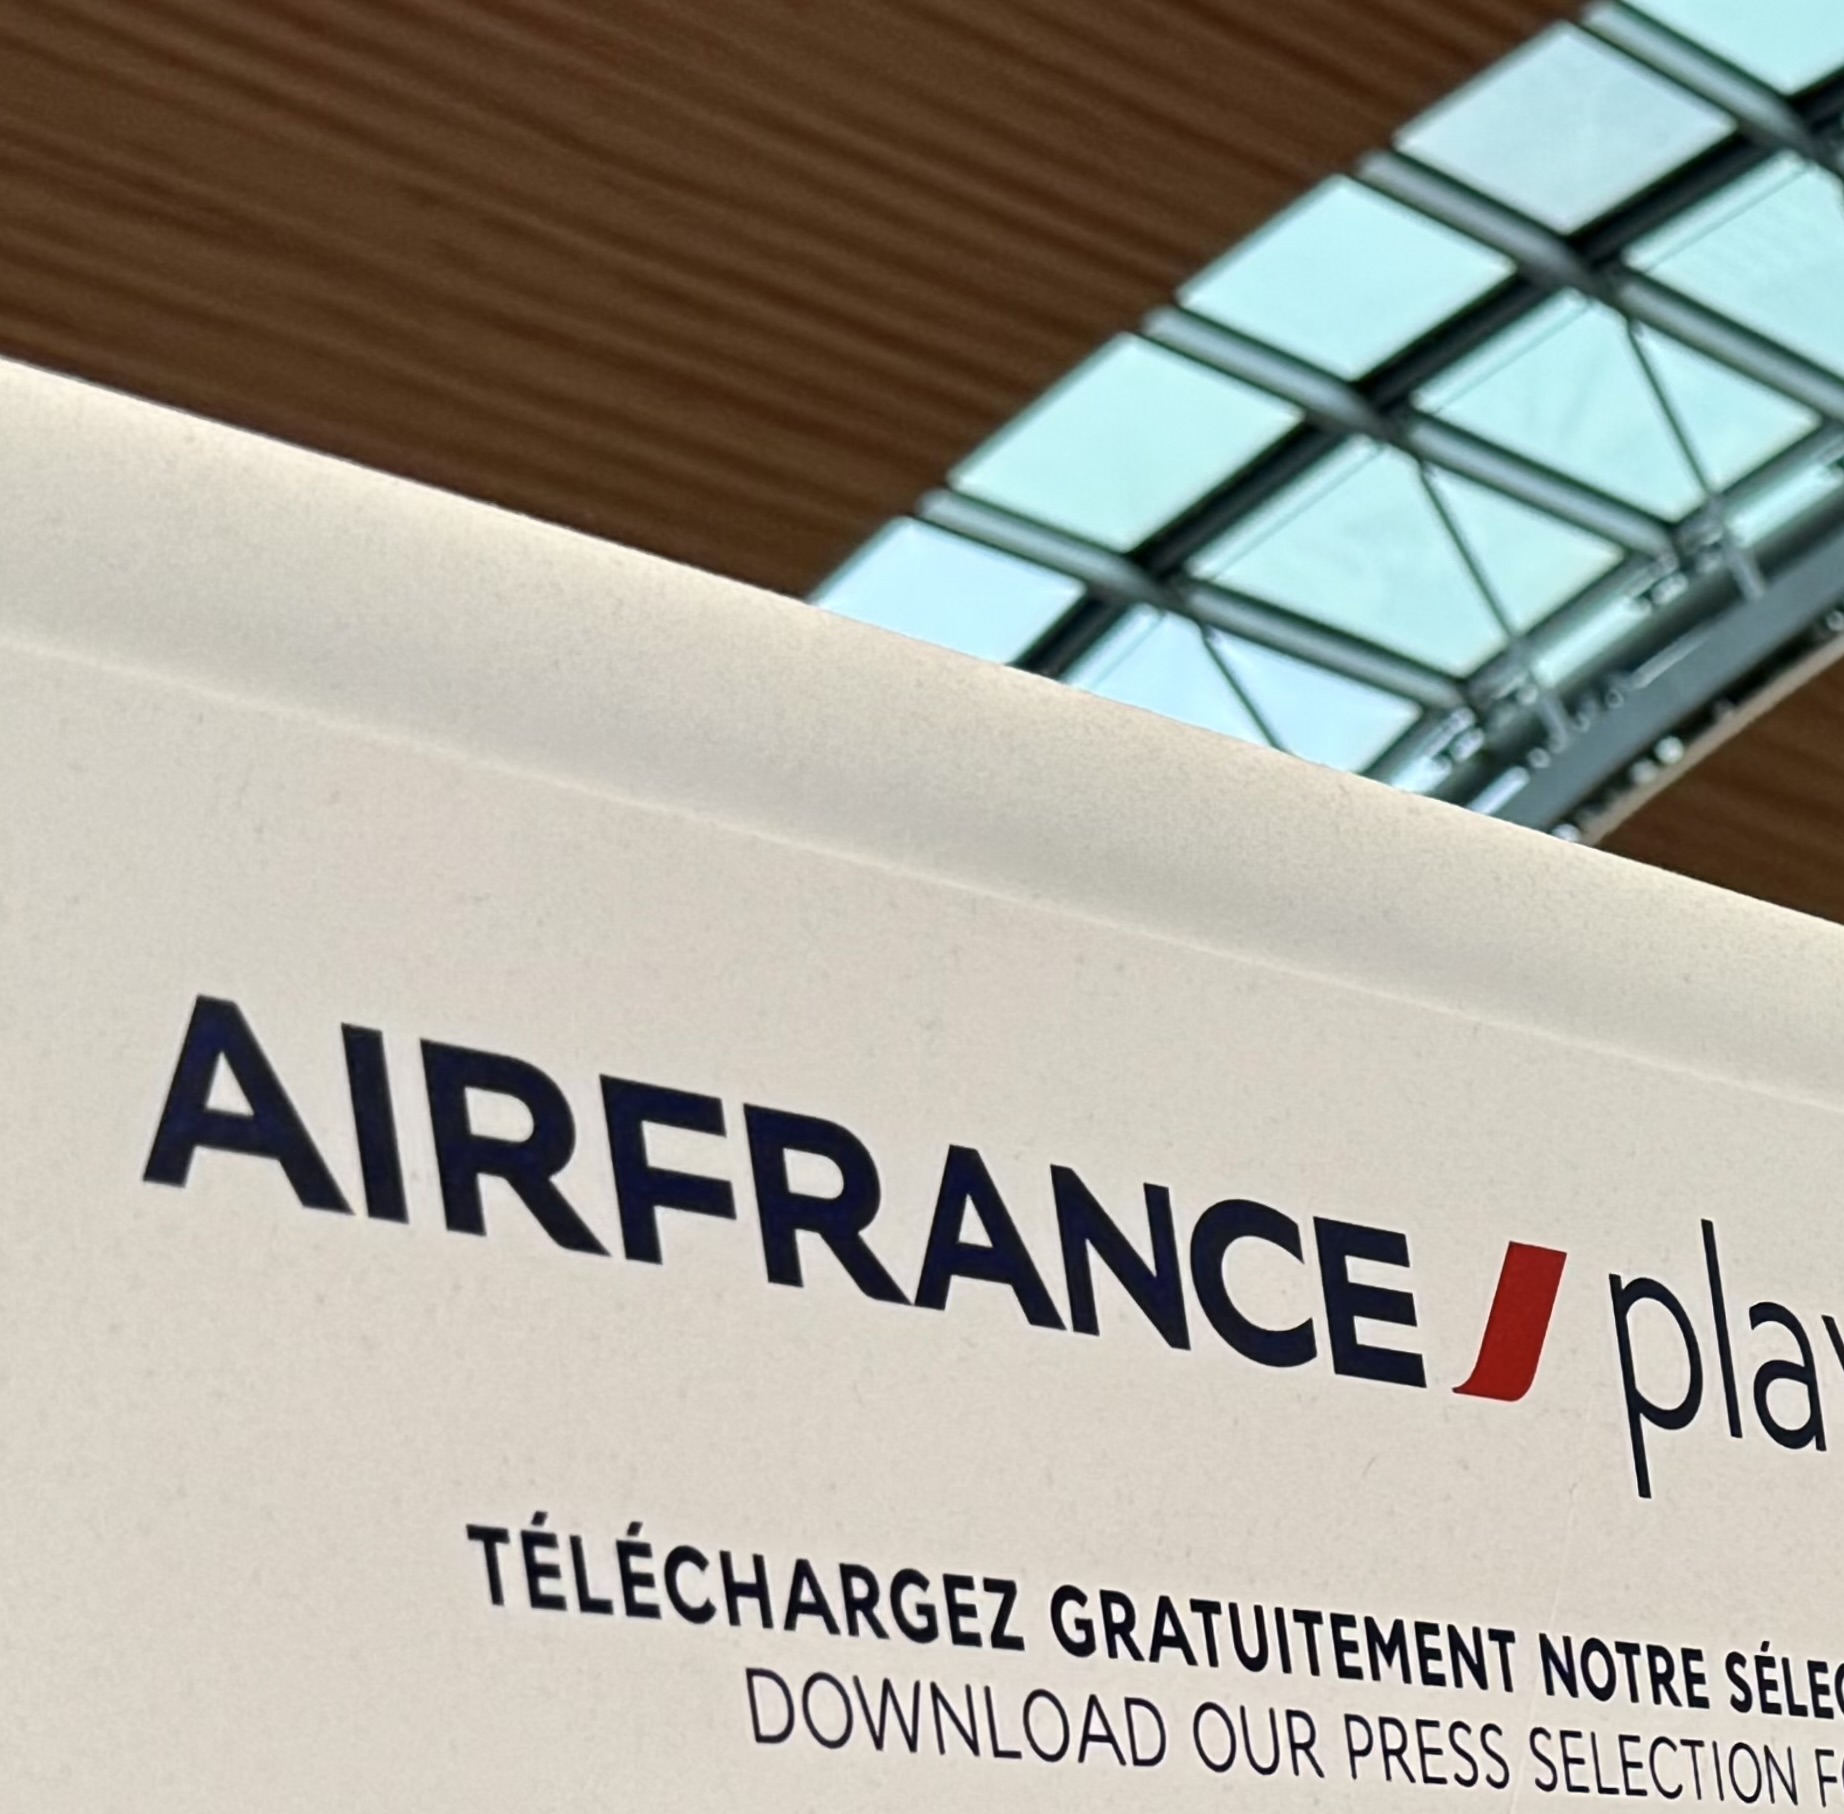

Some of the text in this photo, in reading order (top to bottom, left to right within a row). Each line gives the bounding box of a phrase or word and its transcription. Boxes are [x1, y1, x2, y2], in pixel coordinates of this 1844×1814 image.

[143, 995, 1426, 1388] AIRFRANCE
[466, 1511, 1024, 1651] TÉLÉCHARGEZ
[1051, 1585, 1515, 1692] GRATUITEMENT
[1539, 1633, 1709, 1709] NOTRE
[746, 1668, 1166, 1766] DOWNLOAD
[1193, 1702, 1324, 1778] OUR
[1344, 1714, 1509, 1789] PRESS
[1530, 1727, 1798, 1805] SELECTION
